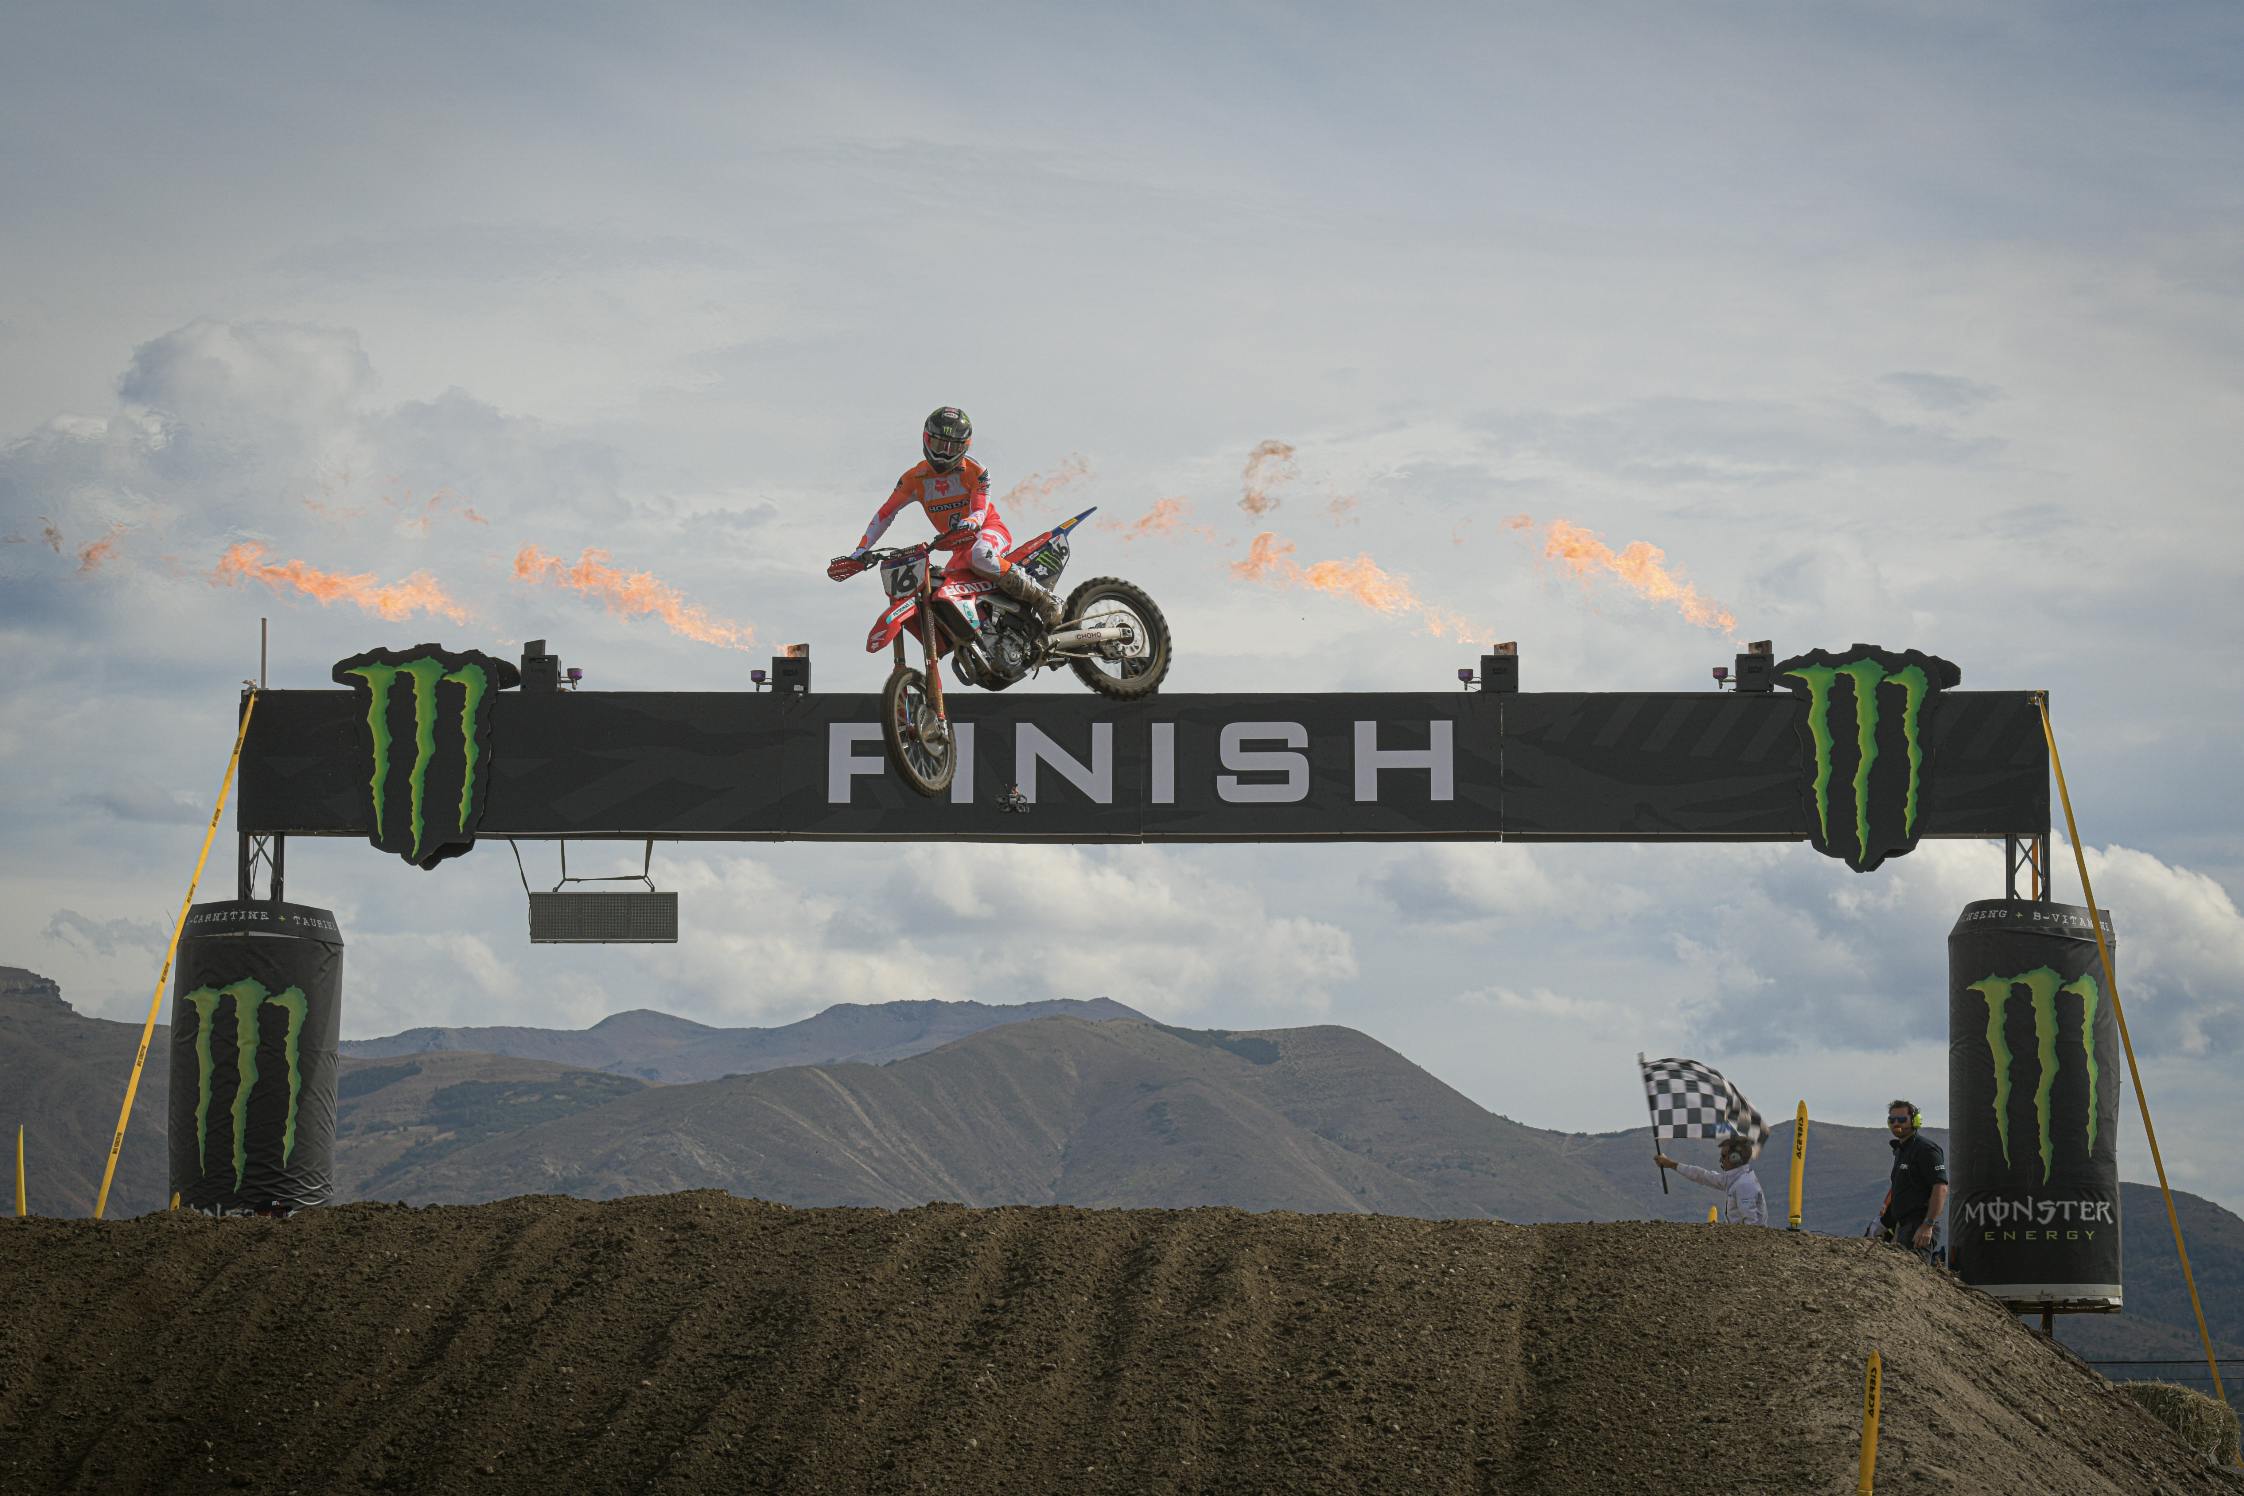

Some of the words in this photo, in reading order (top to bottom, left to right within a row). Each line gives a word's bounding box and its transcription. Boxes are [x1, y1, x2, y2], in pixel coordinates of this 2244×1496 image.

[929, 498, 970, 511] HONDA
[890, 564, 919, 596] 16
[828, 720, 1453, 804] FINISH
[1965, 1195, 2114, 1227] MONSTER
[1984, 1230, 2096, 1241] ENERGY
